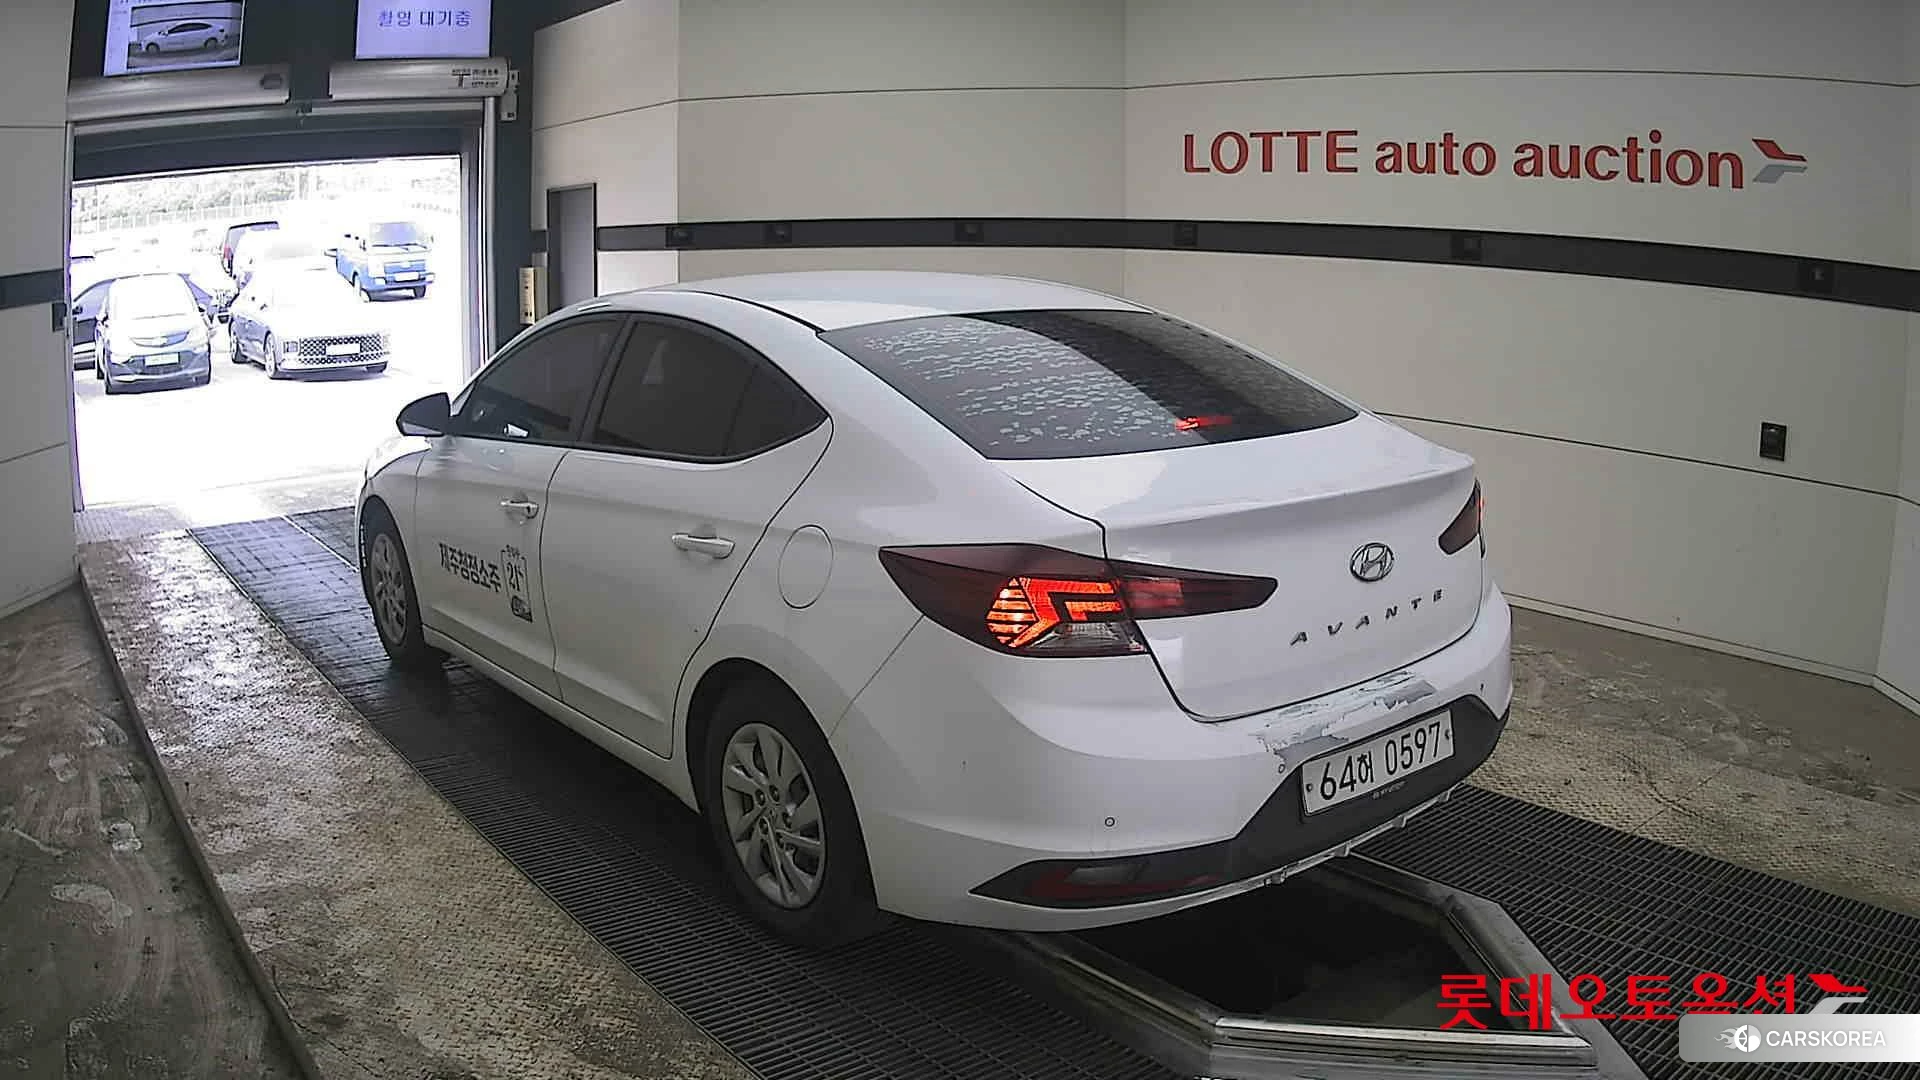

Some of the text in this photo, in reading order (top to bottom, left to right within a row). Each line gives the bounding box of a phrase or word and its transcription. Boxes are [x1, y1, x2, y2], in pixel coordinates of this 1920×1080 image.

[420, 10, 471, 27] 대기중
[1184, 129, 1743, 189] LOTTE auto auction
[1290, 589, 1442, 646] AVANTE
[1320, 721, 1440, 800] 64허 0597
